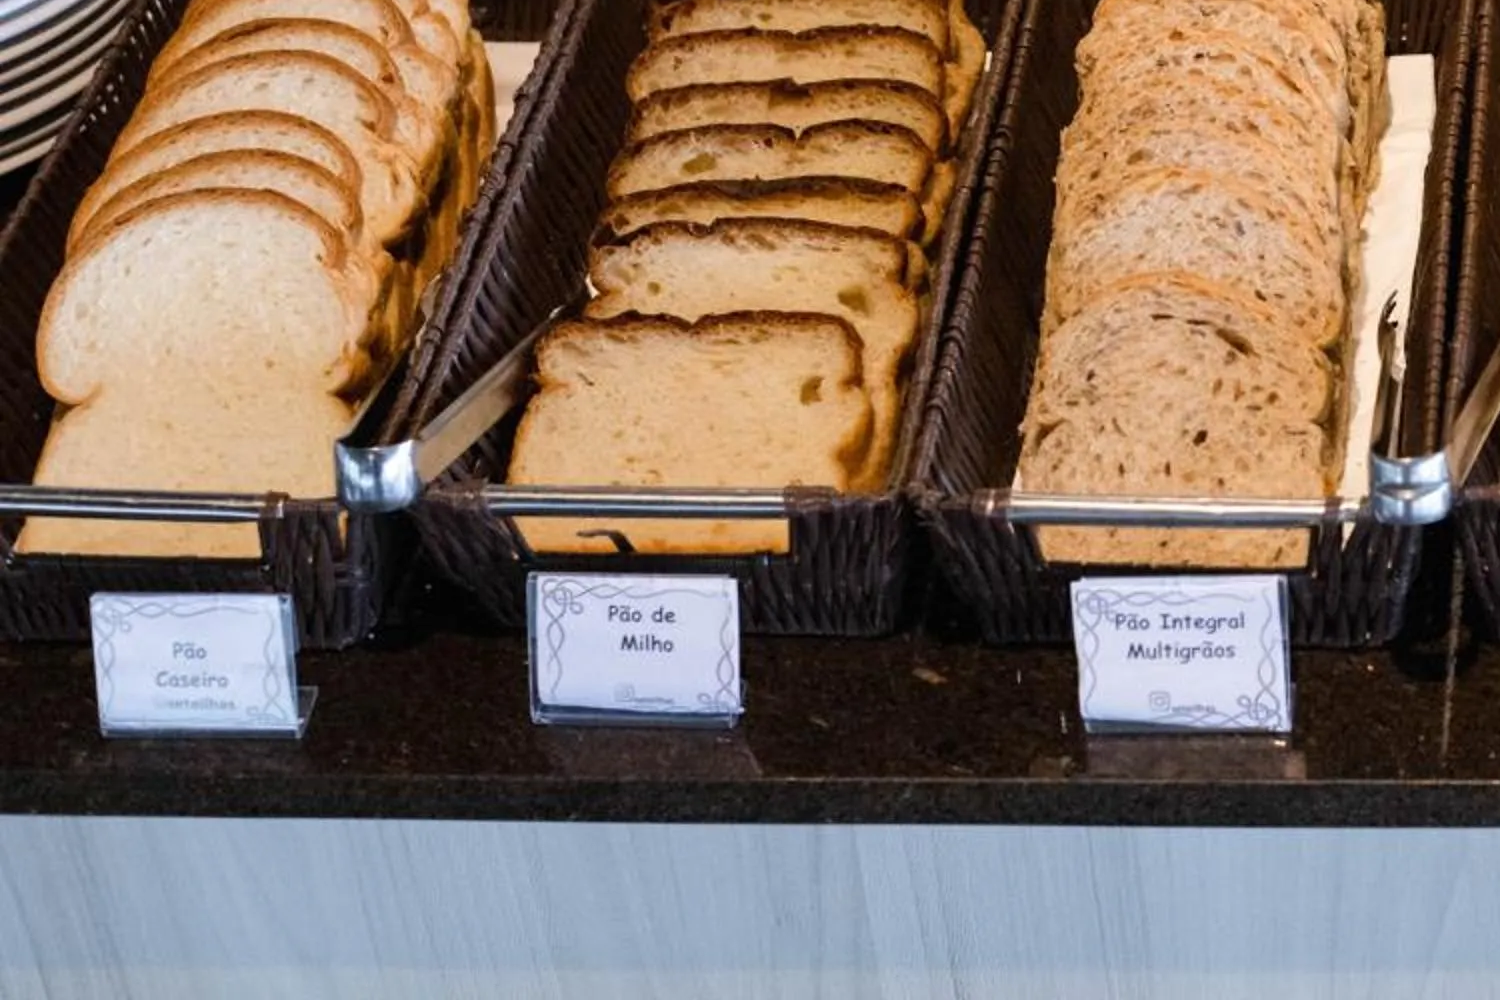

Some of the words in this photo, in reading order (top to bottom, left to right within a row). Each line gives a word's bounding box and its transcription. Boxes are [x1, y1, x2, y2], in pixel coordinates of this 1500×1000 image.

[607, 604, 642, 622] Pão
[651, 606, 676, 623] de
[1115, 612, 1150, 631] Pão
[1160, 611, 1245, 634] Integral
[172, 641, 208, 660] Pão
[620, 634, 674, 652] Milho
[1127, 641, 1236, 664] Multigrãos
[155, 670, 230, 689] Caseiro
